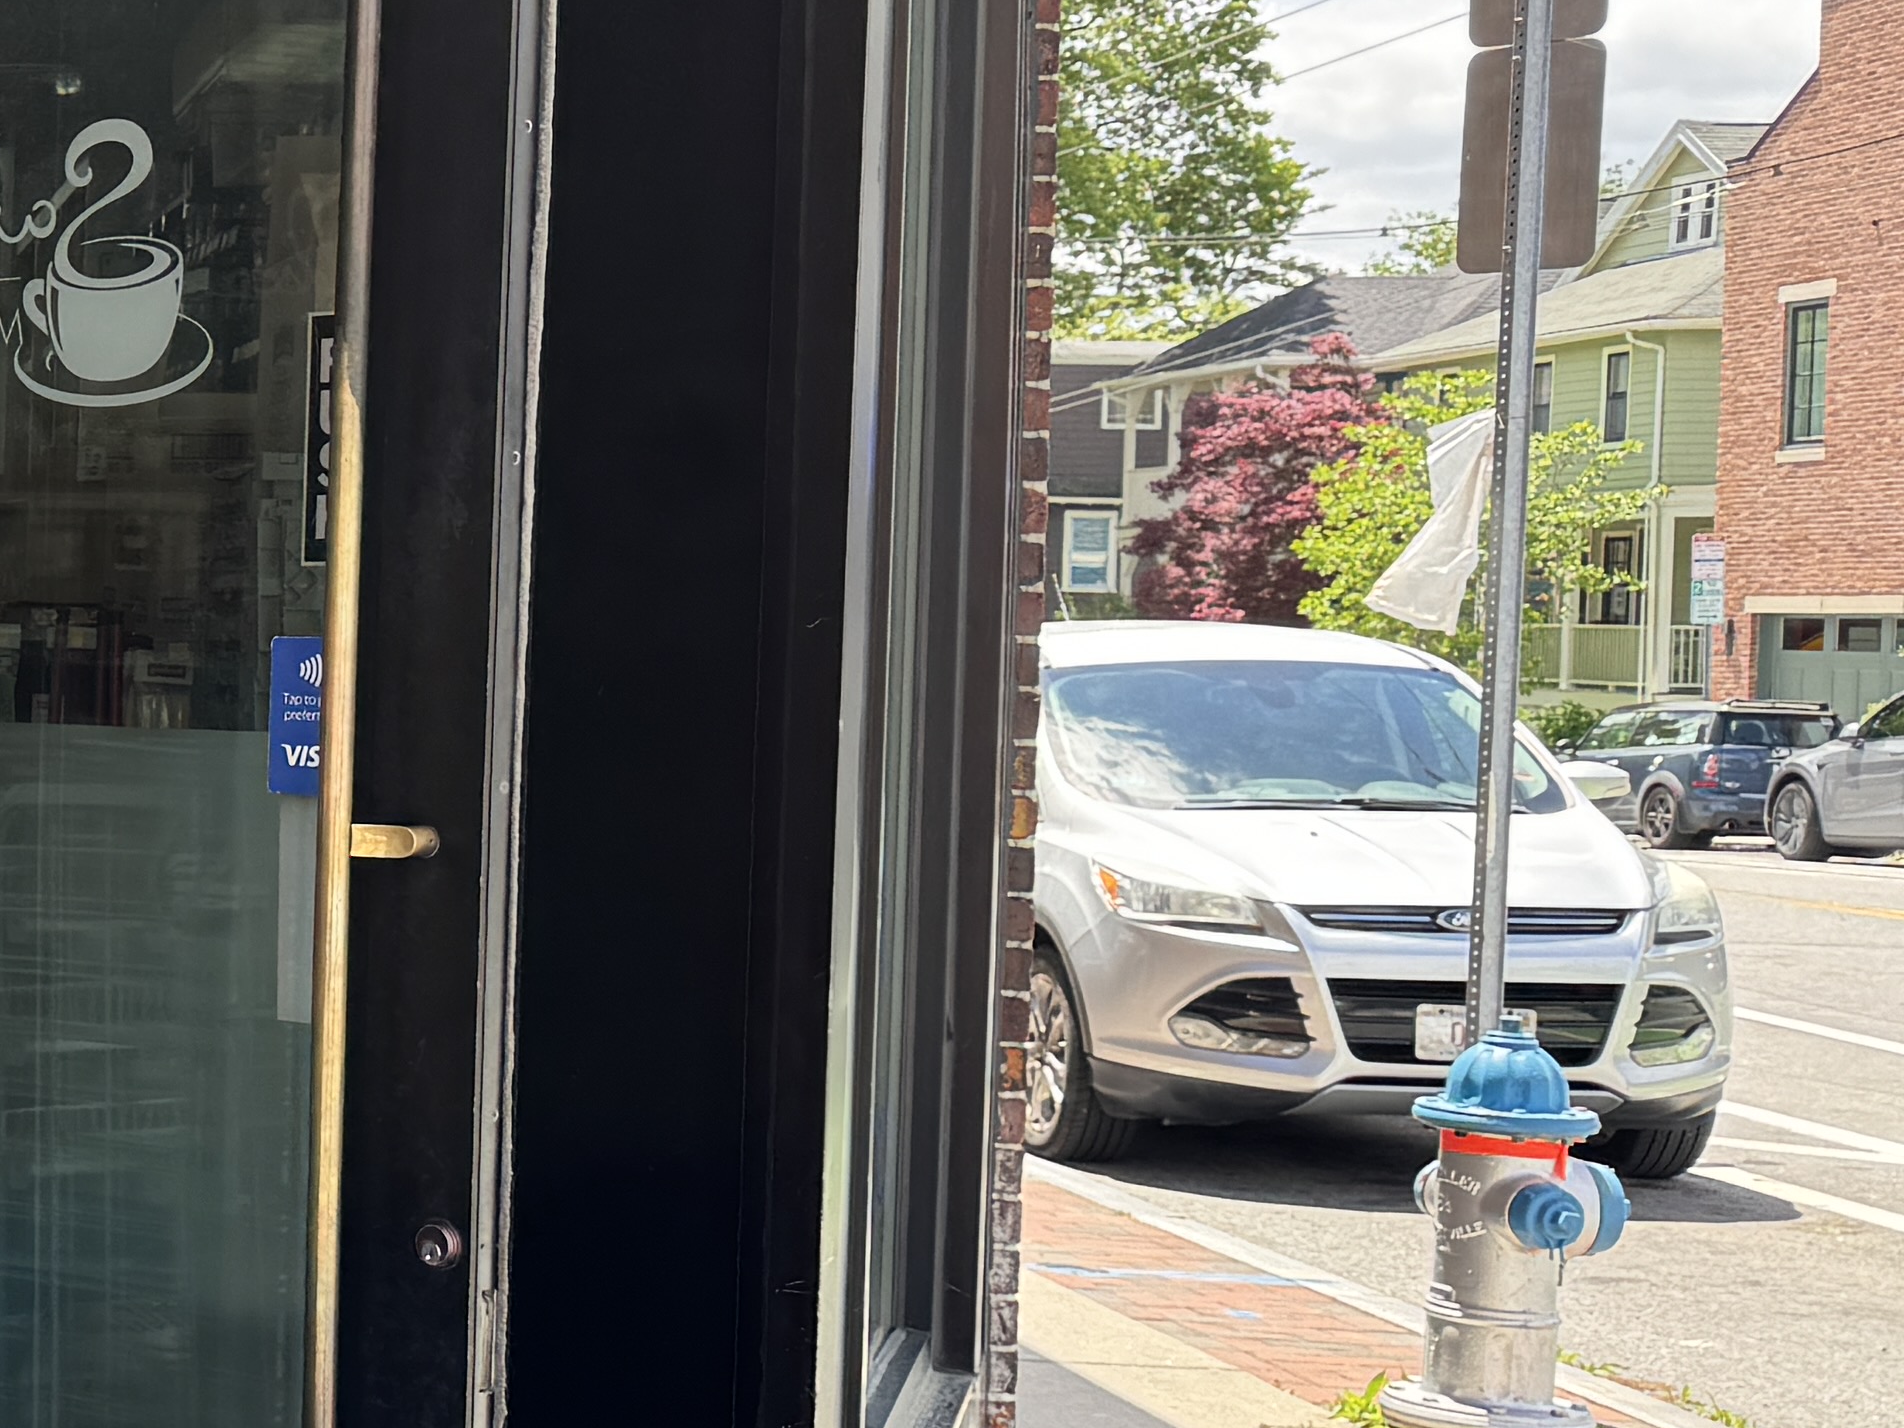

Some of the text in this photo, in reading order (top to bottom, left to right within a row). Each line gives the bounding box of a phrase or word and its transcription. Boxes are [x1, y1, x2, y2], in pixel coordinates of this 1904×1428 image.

[282, 692, 303, 709] Tap
[304, 694, 317, 706] to
[280, 744, 321, 768] VIS
